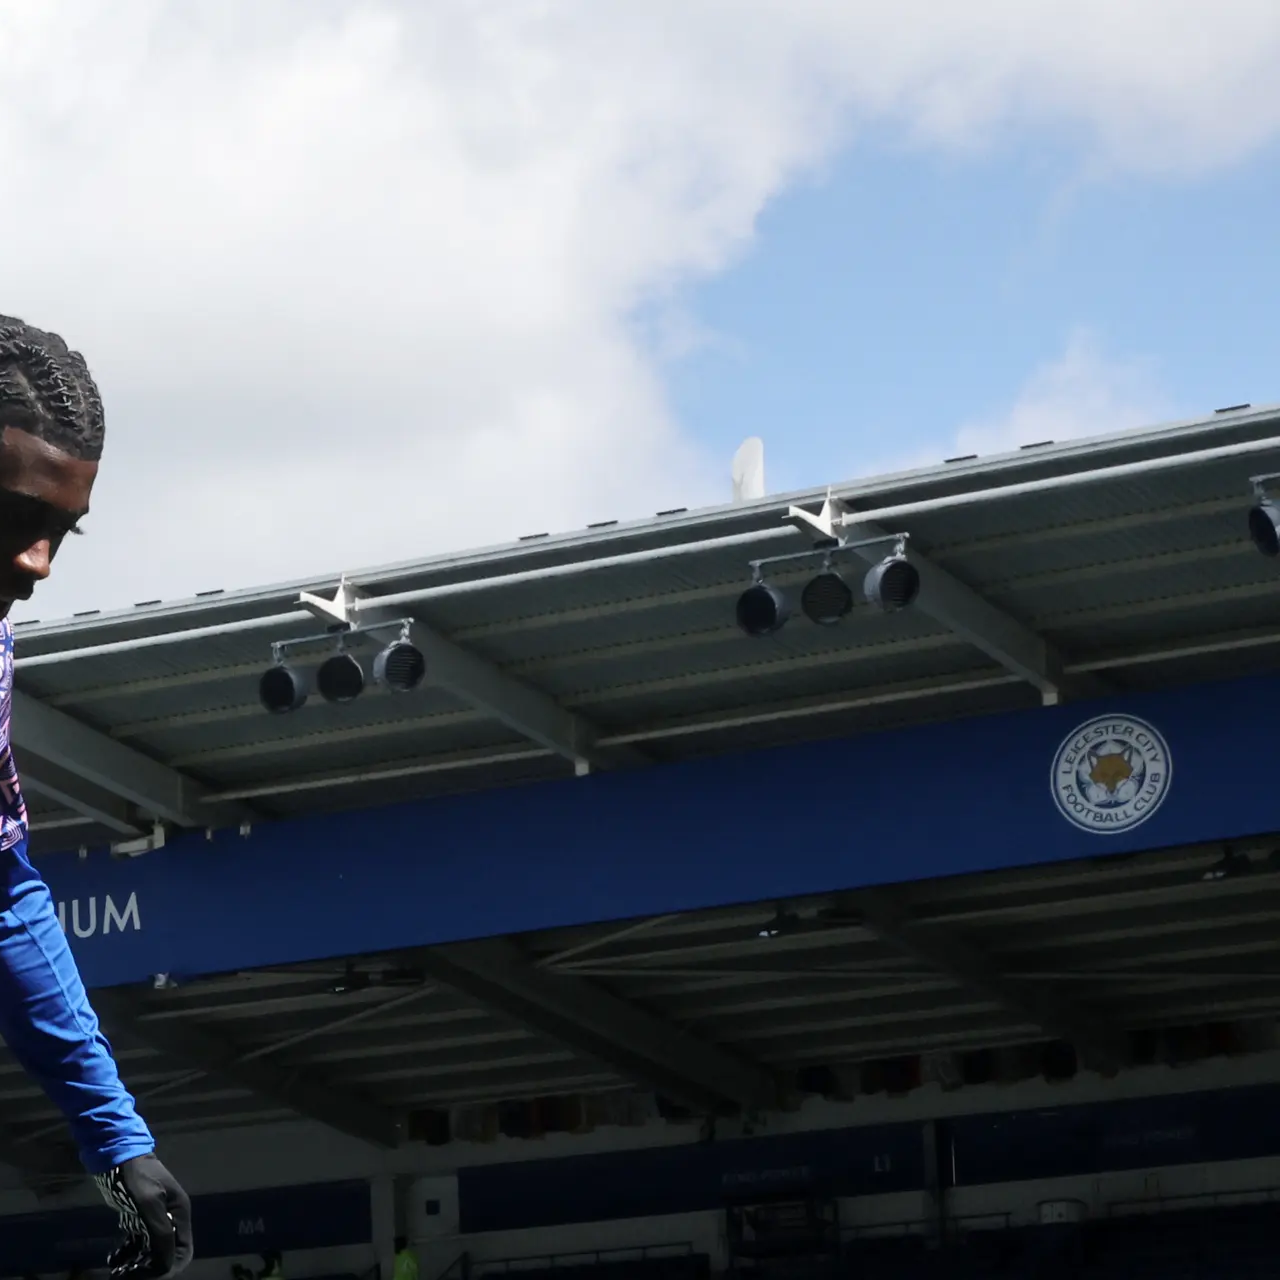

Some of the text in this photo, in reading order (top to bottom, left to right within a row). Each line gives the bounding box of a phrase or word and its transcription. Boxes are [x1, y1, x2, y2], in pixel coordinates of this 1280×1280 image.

[1062, 724, 1161, 774] LEICESTER CITY
[1062, 772, 1161, 823] FOOTBALL CLUB
